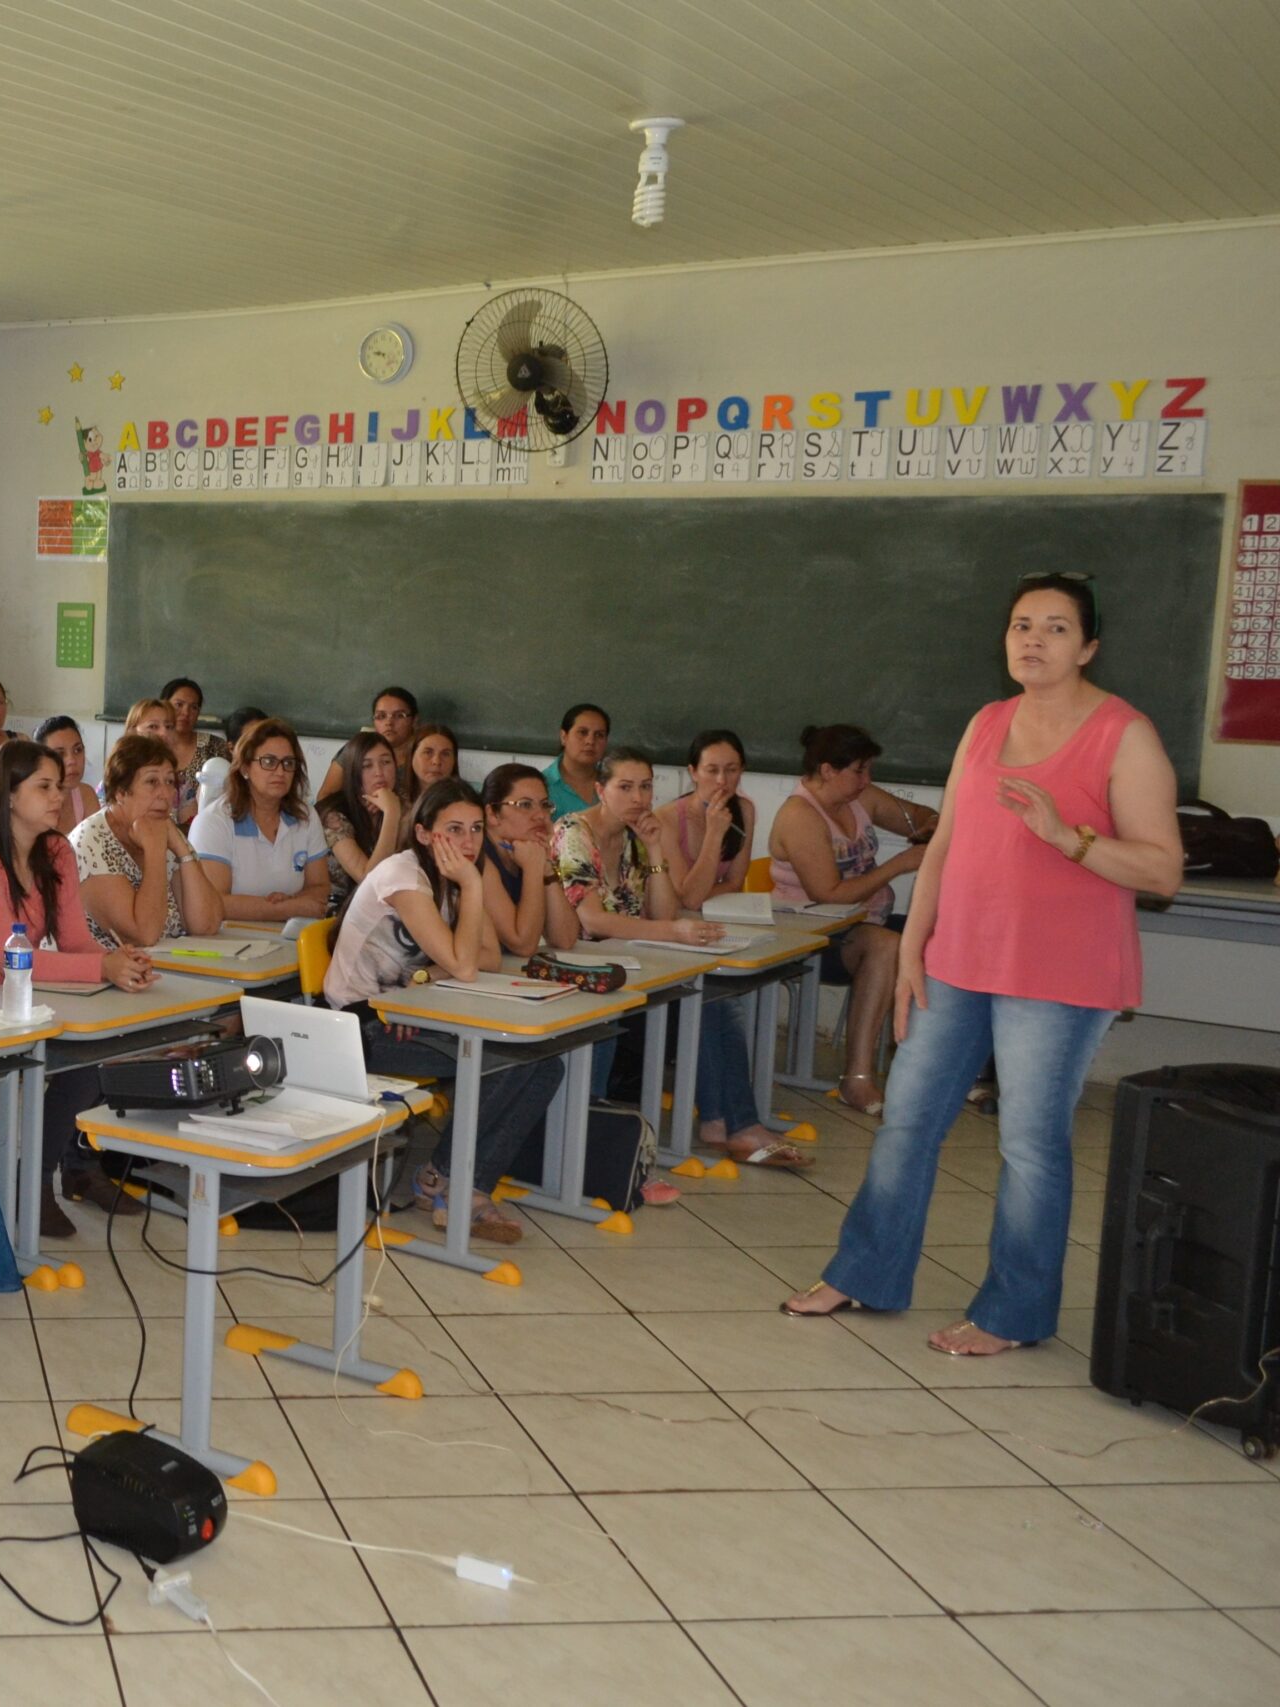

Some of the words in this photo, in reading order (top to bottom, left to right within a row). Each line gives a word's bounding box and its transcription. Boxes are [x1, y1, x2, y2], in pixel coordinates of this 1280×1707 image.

[117, 421, 140, 452] A
[147, 420, 169, 450] B
[176, 420, 197, 448] C
[206, 418, 229, 448] D
[235, 416, 258, 447] E
[265, 415, 288, 446] F
[295, 416, 319, 445] G
[328, 412, 354, 444] H
[368, 411, 379, 443] I
[392, 410, 419, 441] J
[428, 406, 456, 441] K
[464, 406, 490, 440] L
[595, 400, 627, 436] N
[635, 400, 666, 436] O
[676, 397, 707, 433] P
[717, 395, 750, 432] Q
[761, 394, 794, 431] R
[807, 391, 842, 429] S
[854, 390, 891, 429] T
[906, 387, 942, 427] U
[950, 386, 988, 426] V
[1001, 384, 1041, 426] W
[1055, 383, 1095, 424] X
[1109, 378, 1149, 421] Y
[1160, 377, 1206, 422] Z
[117, 453, 127, 473] A
[146, 452, 156, 472] B
[174, 451, 185, 471] C
[204, 450, 214, 471] D
[232, 449, 244, 470] E
[263, 448, 276, 469] F
[296, 447, 307, 468] G
[326, 444, 339, 467] H
[393, 445, 403, 465] J
[426, 443, 439, 465] K
[462, 442, 474, 464] L
[497, 440, 511, 464] M
[593, 438, 608, 461] N
[674, 436, 689, 459] P
[716, 434, 732, 459] Q
[759, 434, 775, 458] R
[805, 432, 821, 457] S
[852, 431, 869, 456] T
[898, 430, 917, 456] U
[948, 428, 966, 454] V
[1000, 427, 1017, 453] W
[1050, 425, 1069, 452] X
[1106, 424, 1123, 451] Y
[1158, 422, 1181, 450] Z
[1247, 517, 1253, 530] 1
[1266, 516, 1277, 529] 2
[1262, 537, 1279, 548] 12
[1260, 553, 1279, 565] 22
[1258, 570, 1276, 582] 32
[1256, 586, 1275, 598] 42
[1255, 603, 1273, 614] 52
[1252, 618, 1270, 630] 62
[1249, 634, 1267, 646] 72
[1247, 650, 1266, 661] 82
[1246, 666, 1265, 677] 92
